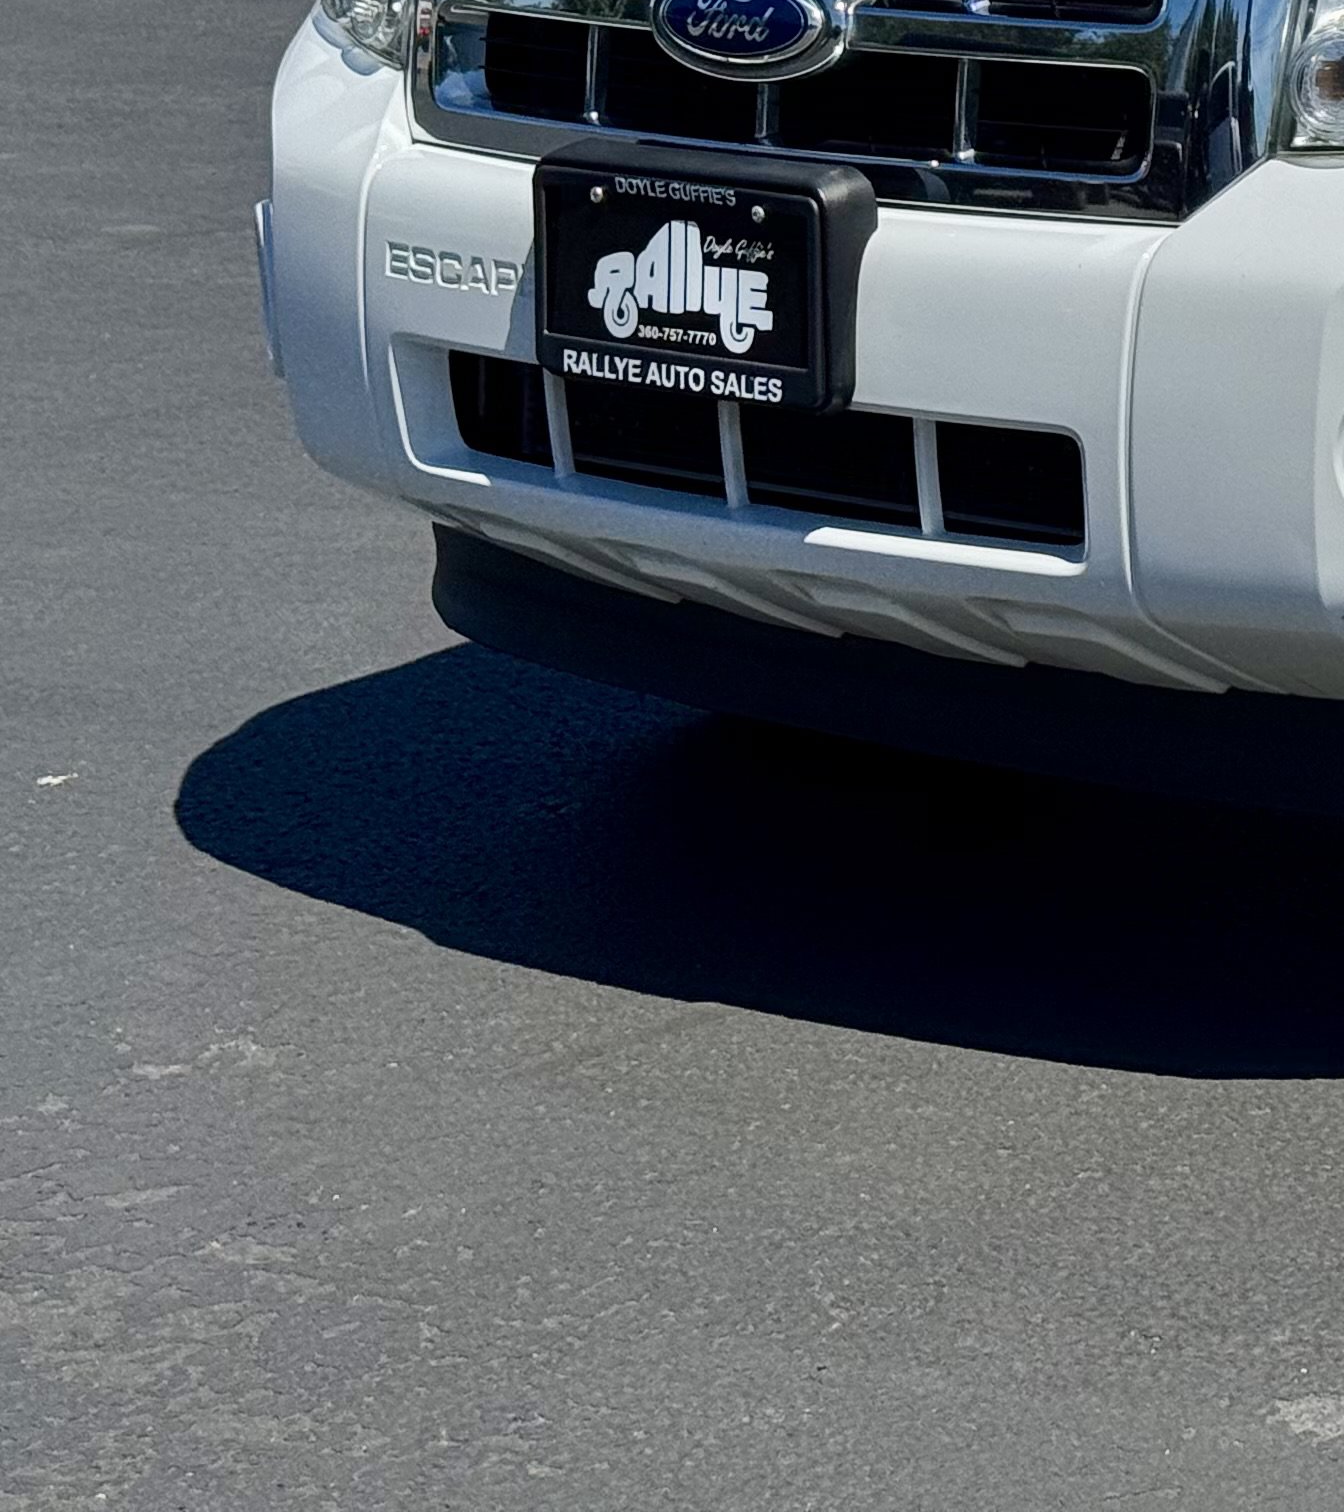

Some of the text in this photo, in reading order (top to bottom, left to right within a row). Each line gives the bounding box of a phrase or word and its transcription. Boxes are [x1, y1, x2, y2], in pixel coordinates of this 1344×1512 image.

[615, 176, 667, 198] DOYLE
[384, 240, 526, 296] ESCAP
[637, 324, 717, 346] 360-757-7770
[563, 349, 783, 404] RALLYE AUTO SALES
